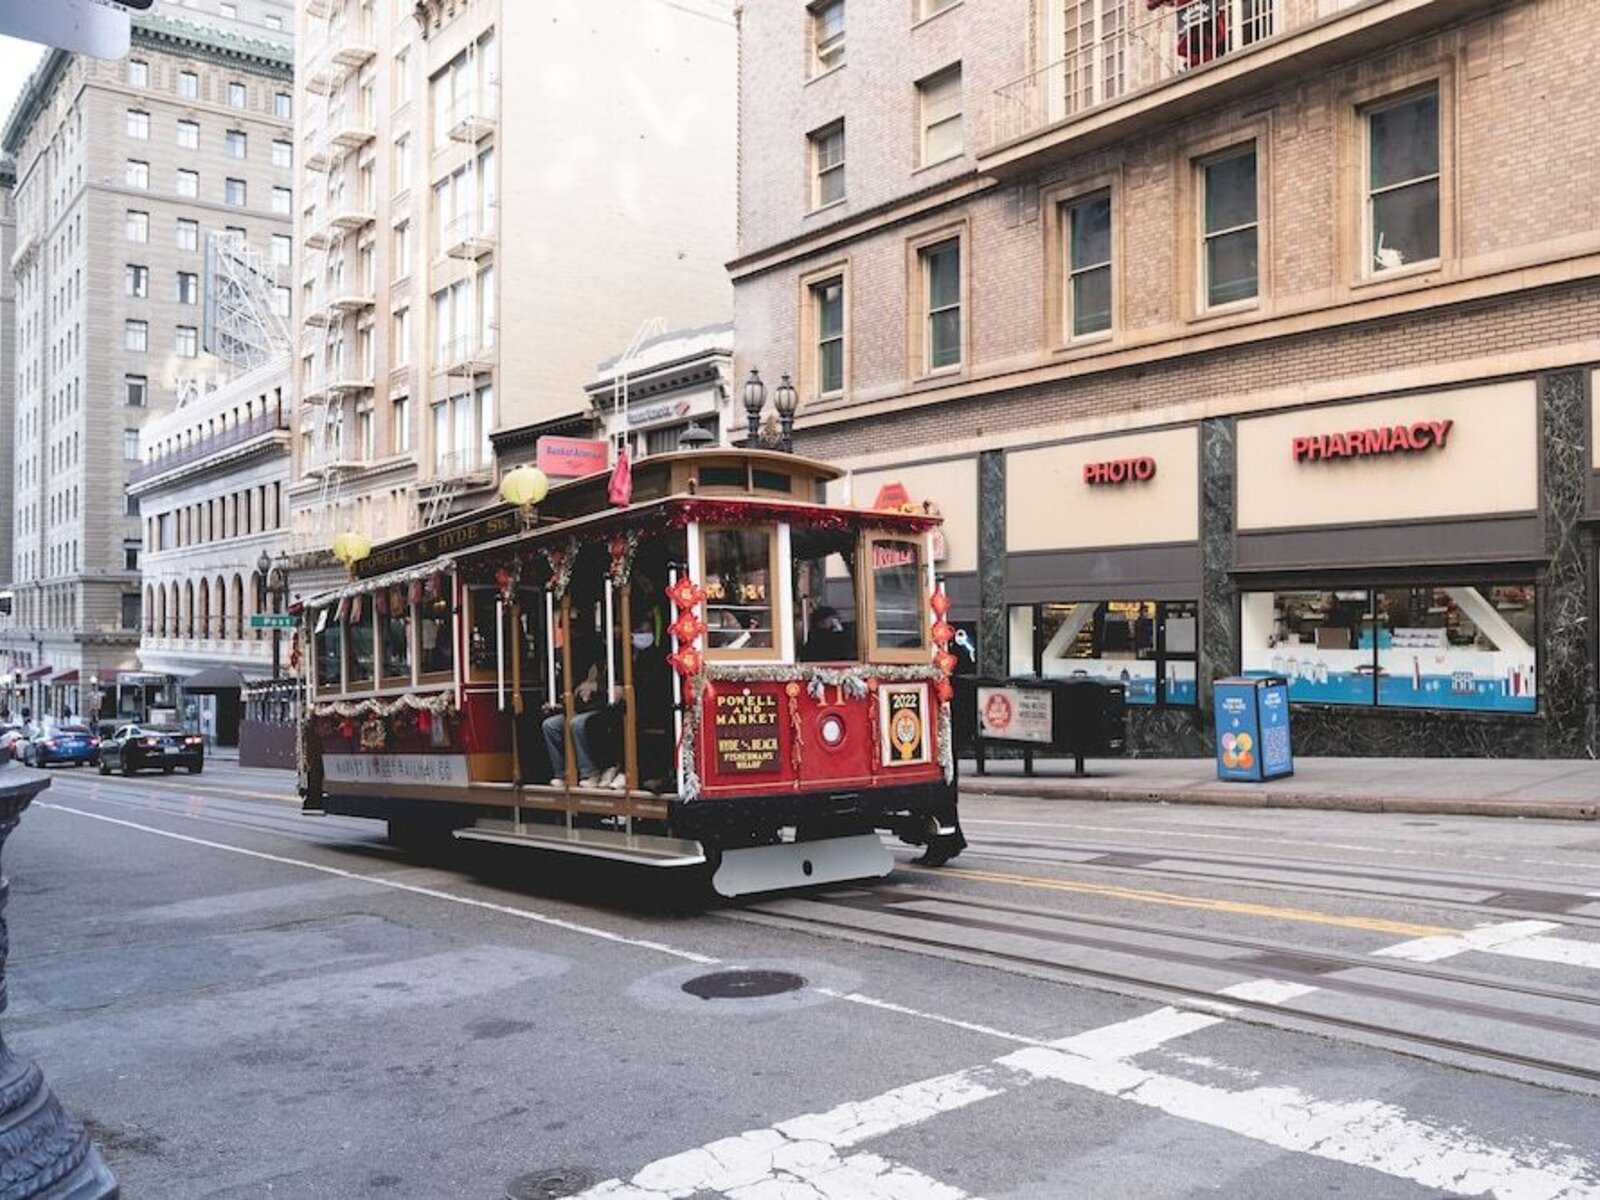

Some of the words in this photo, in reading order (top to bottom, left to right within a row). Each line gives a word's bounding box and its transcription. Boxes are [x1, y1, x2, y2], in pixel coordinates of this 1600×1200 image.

[1292, 420, 1453, 462] PHARMACY
[1083, 456, 1156, 485] PHOTO
[438, 525, 479, 549] HYDE
[264, 618, 291, 626] Post
[717, 695, 776, 707] POWELL
[893, 694, 918, 709] 2022
[733, 705, 762, 715] AND
[716, 713, 777, 726] MARKET
